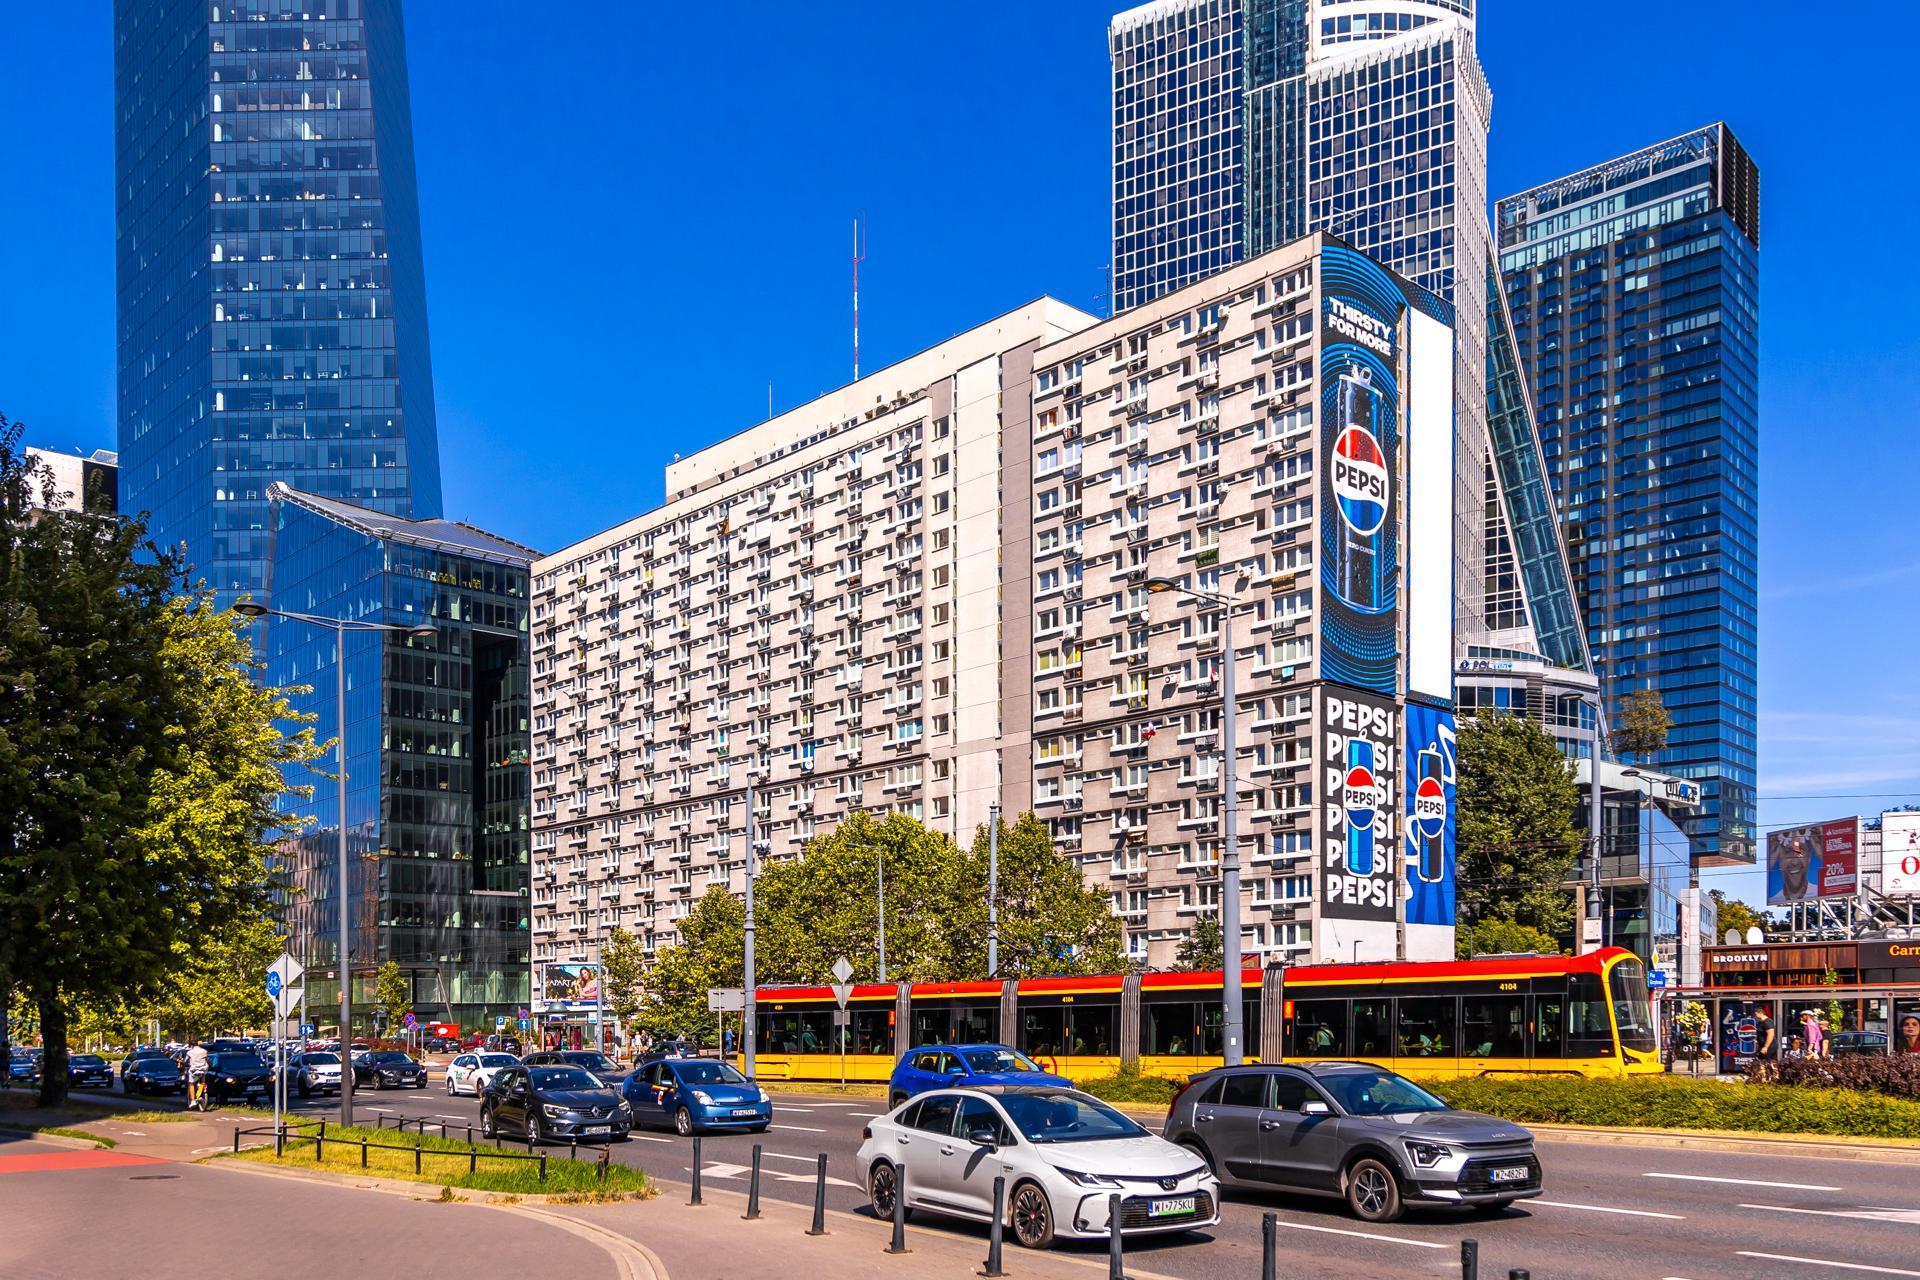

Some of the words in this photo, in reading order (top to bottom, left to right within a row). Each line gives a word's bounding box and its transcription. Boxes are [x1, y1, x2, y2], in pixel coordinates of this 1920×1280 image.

[1329, 297, 1391, 340] THIRSTY
[1329, 314, 1355, 339] FOR
[1356, 328, 1391, 356] MORE
[1336, 460, 1384, 500] PEPSI
[1326, 696, 1394, 738] PEPSI
[1326, 732, 1394, 772] PSI
[1345, 789, 1376, 806] PEPSI
[1417, 799, 1444, 815] PEPSI
[1326, 803, 1394, 839] PSI
[1326, 838, 1394, 874] PSI
[1826, 862, 1845, 876] 20%
[1326, 874, 1394, 908] PEPSI
[1713, 954, 1768, 963] BROOKLYN
[549, 979, 571, 987] APART
